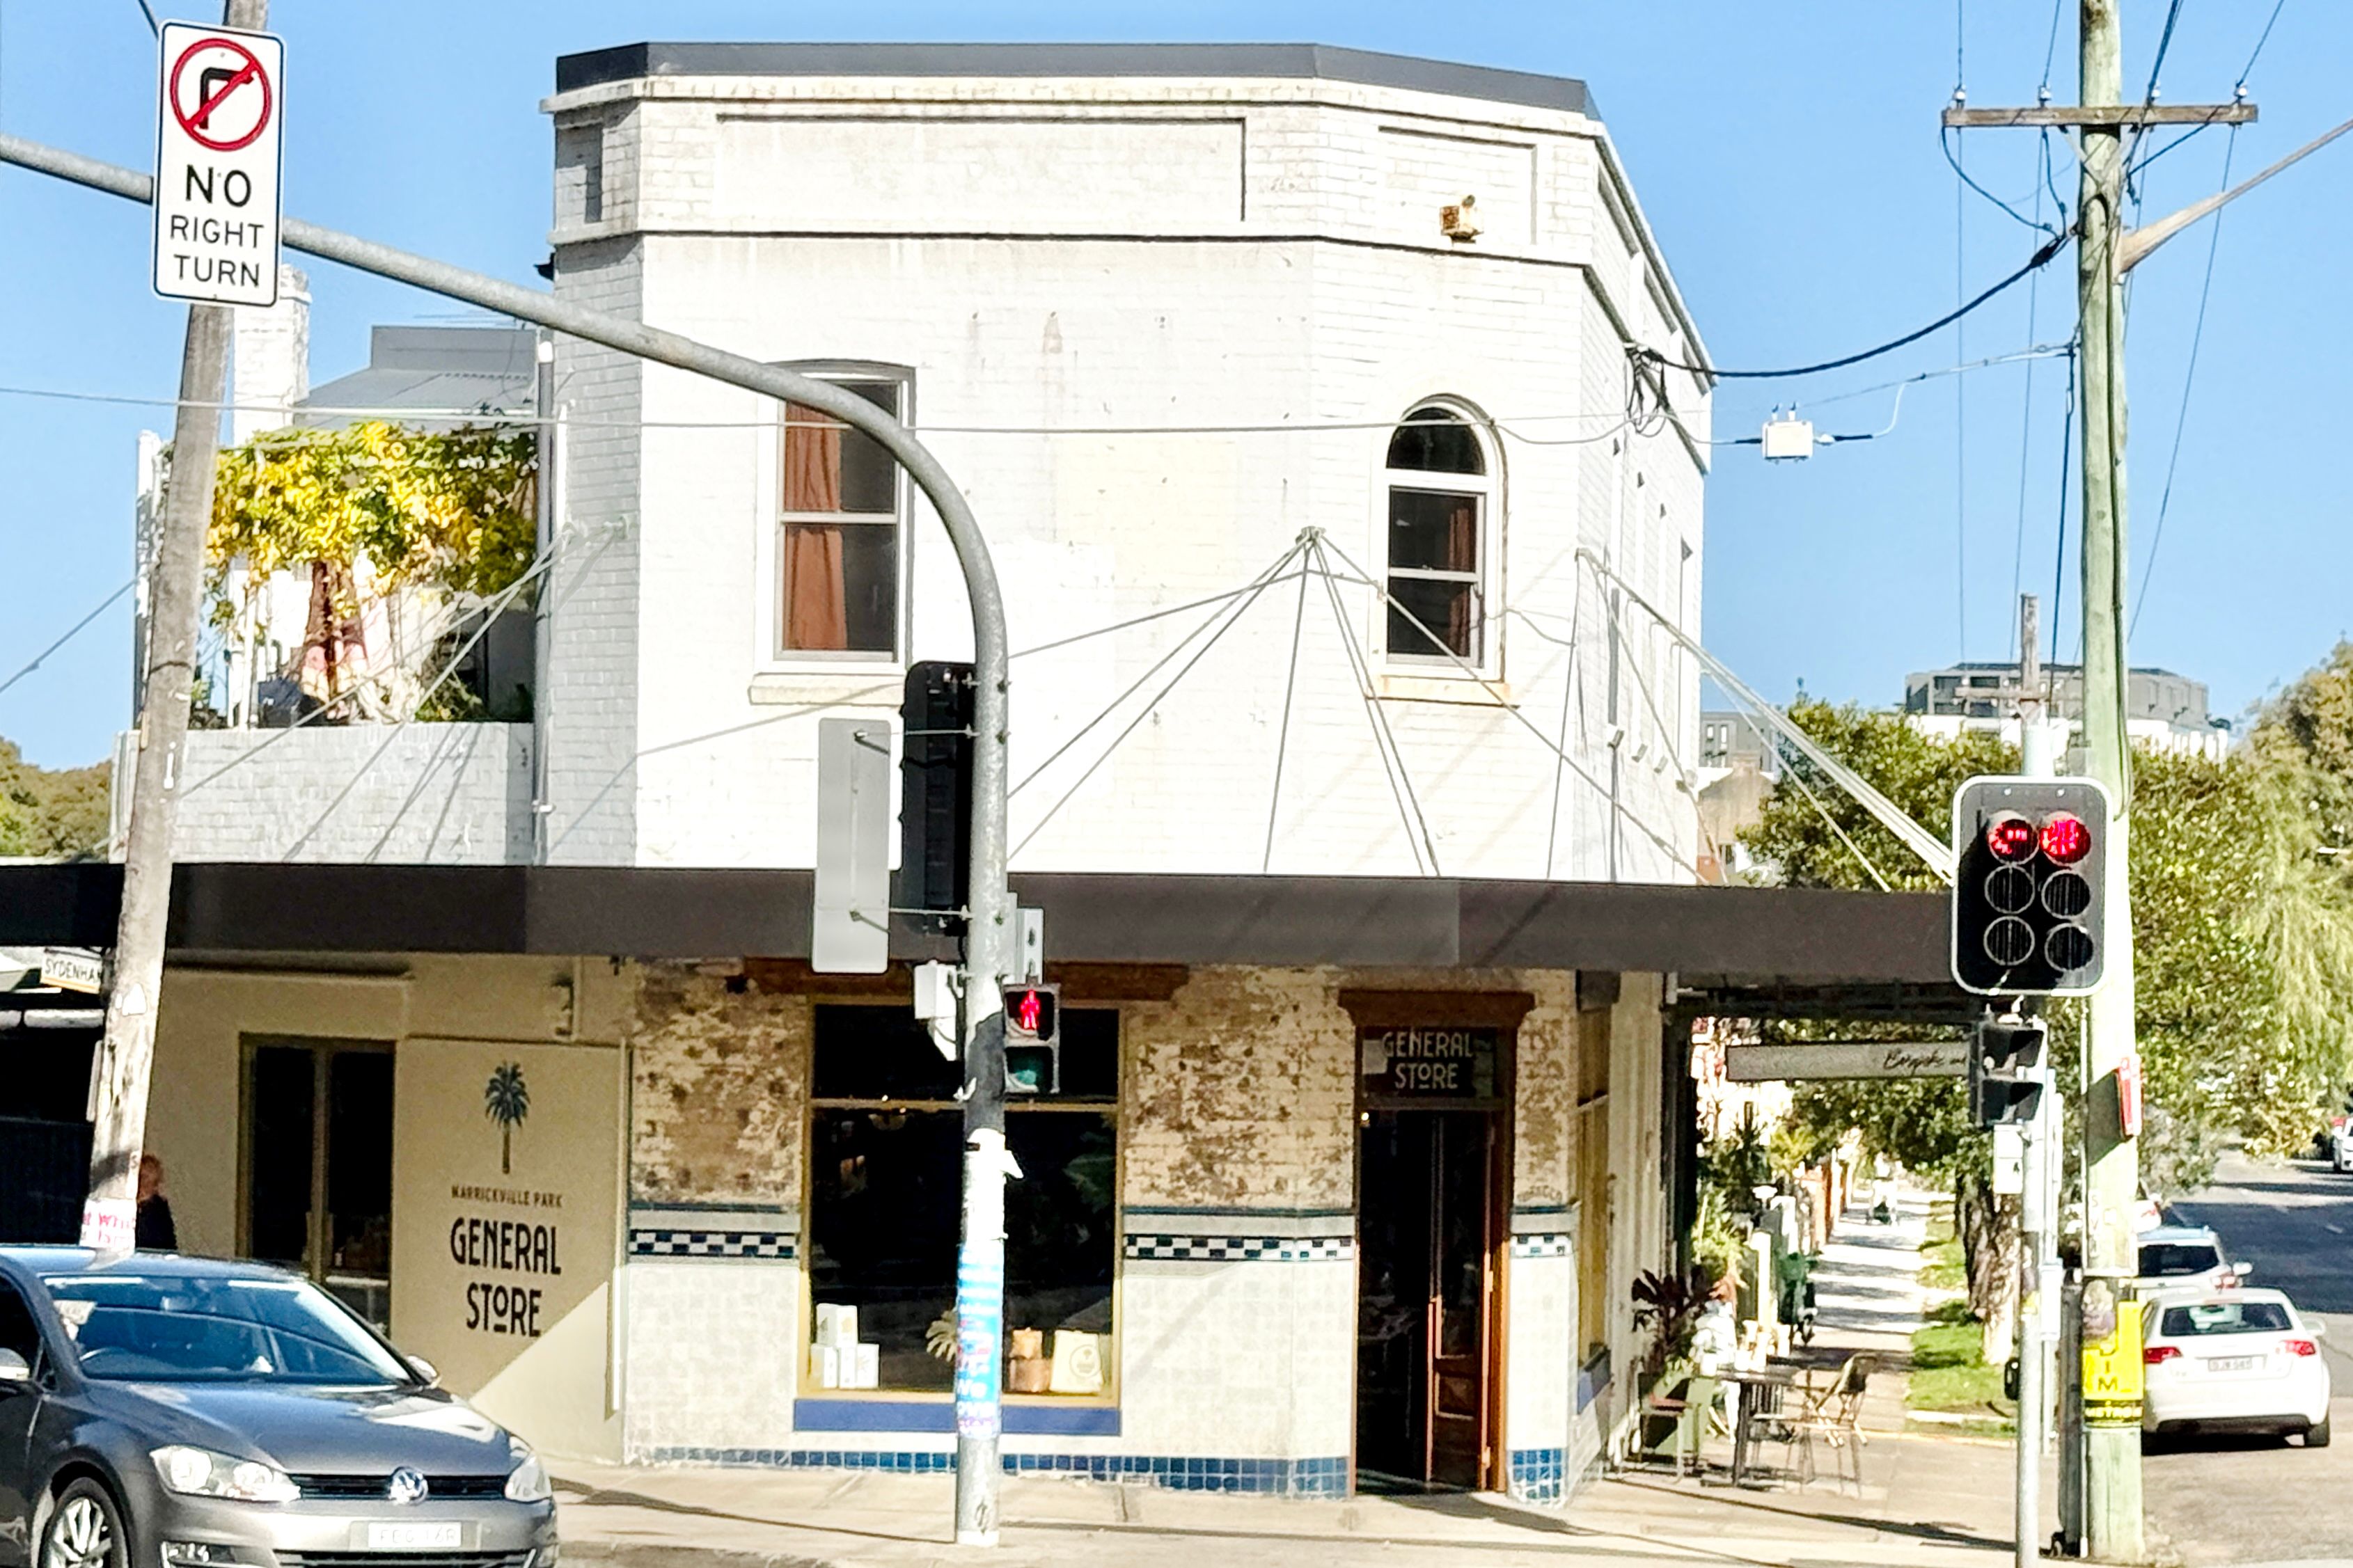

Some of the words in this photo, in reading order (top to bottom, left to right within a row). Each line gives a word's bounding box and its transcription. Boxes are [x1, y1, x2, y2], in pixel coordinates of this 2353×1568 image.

[186, 164, 251, 207] NO
[170, 214, 265, 248] RIGHT
[173, 254, 260, 287] TURN
[45, 958, 102, 983] SYDENHA
[1382, 1029, 1474, 1058] GENERAL
[1394, 1063, 1459, 1089] STORE
[534, 1191, 562, 1208] PARK
[450, 1217, 562, 1276] GENERAL
[466, 1282, 542, 1338] STORE
